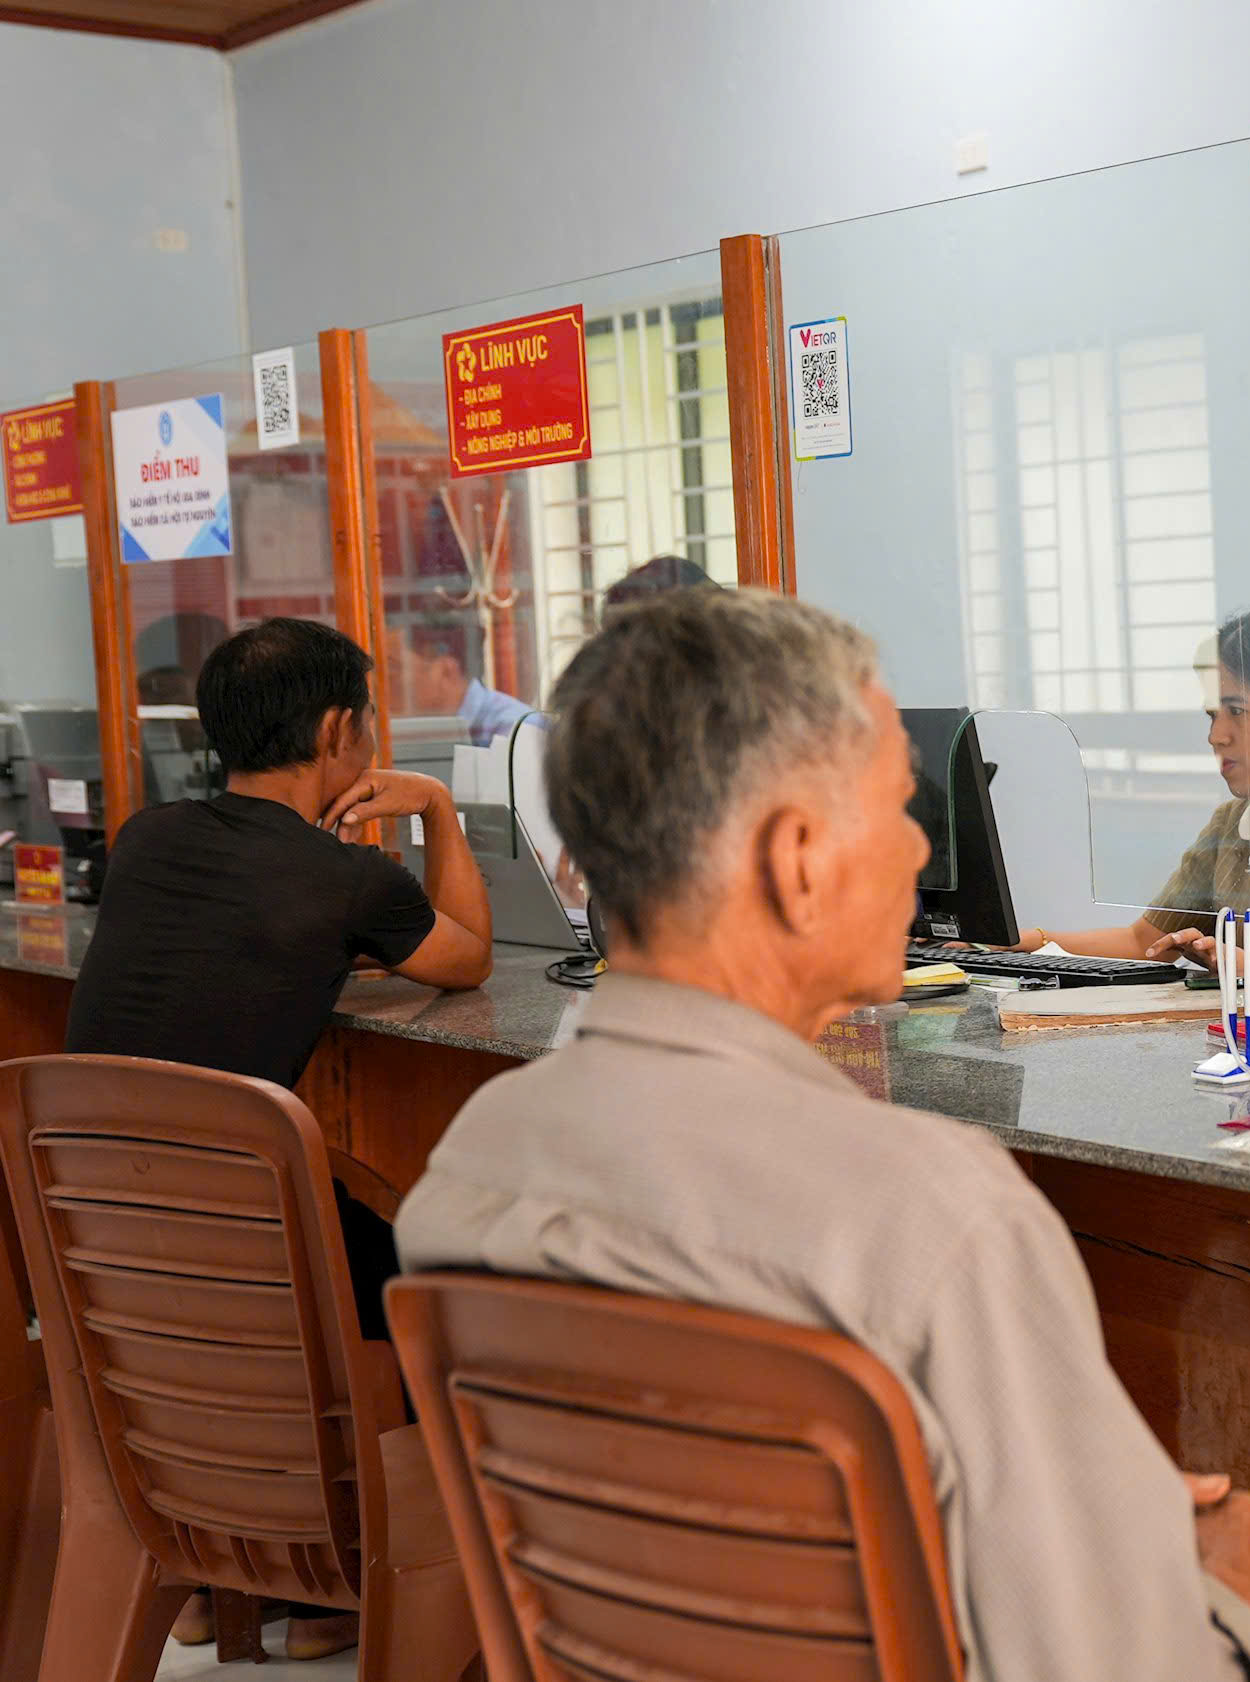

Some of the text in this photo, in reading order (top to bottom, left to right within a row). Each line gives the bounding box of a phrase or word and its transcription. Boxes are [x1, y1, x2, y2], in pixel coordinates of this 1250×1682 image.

[516, 335, 548, 368] VỰC
[140, 449, 200, 484] ĐIỂM THU
